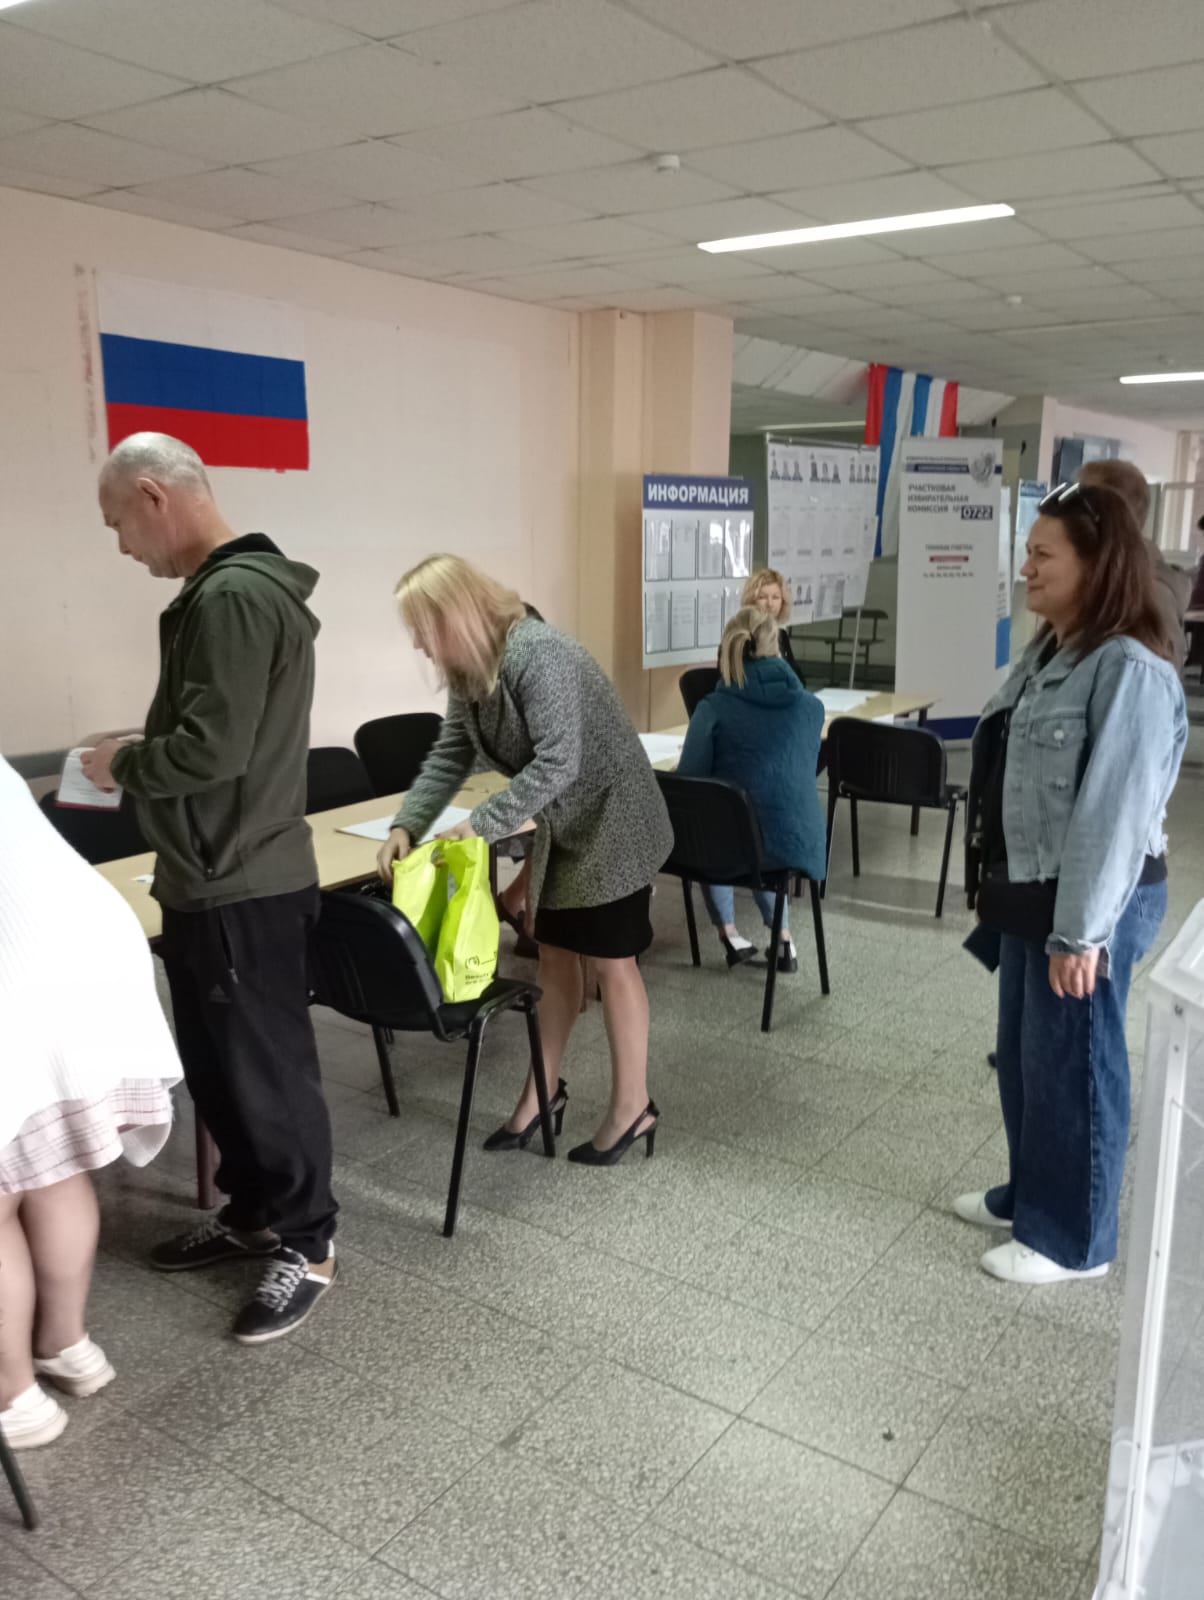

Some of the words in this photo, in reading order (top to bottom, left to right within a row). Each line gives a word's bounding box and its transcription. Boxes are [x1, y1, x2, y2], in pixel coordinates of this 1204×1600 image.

[909, 484, 956, 492] УЧАСТКОВАЯ
[648, 483, 749, 507] ИНФОРМАЦИЯ
[907, 494, 969, 503] ИЗБИРАТЕЛЬНАЯ
[907, 504, 949, 513] КОМИССИЯ
[963, 507, 991, 518] 0722
